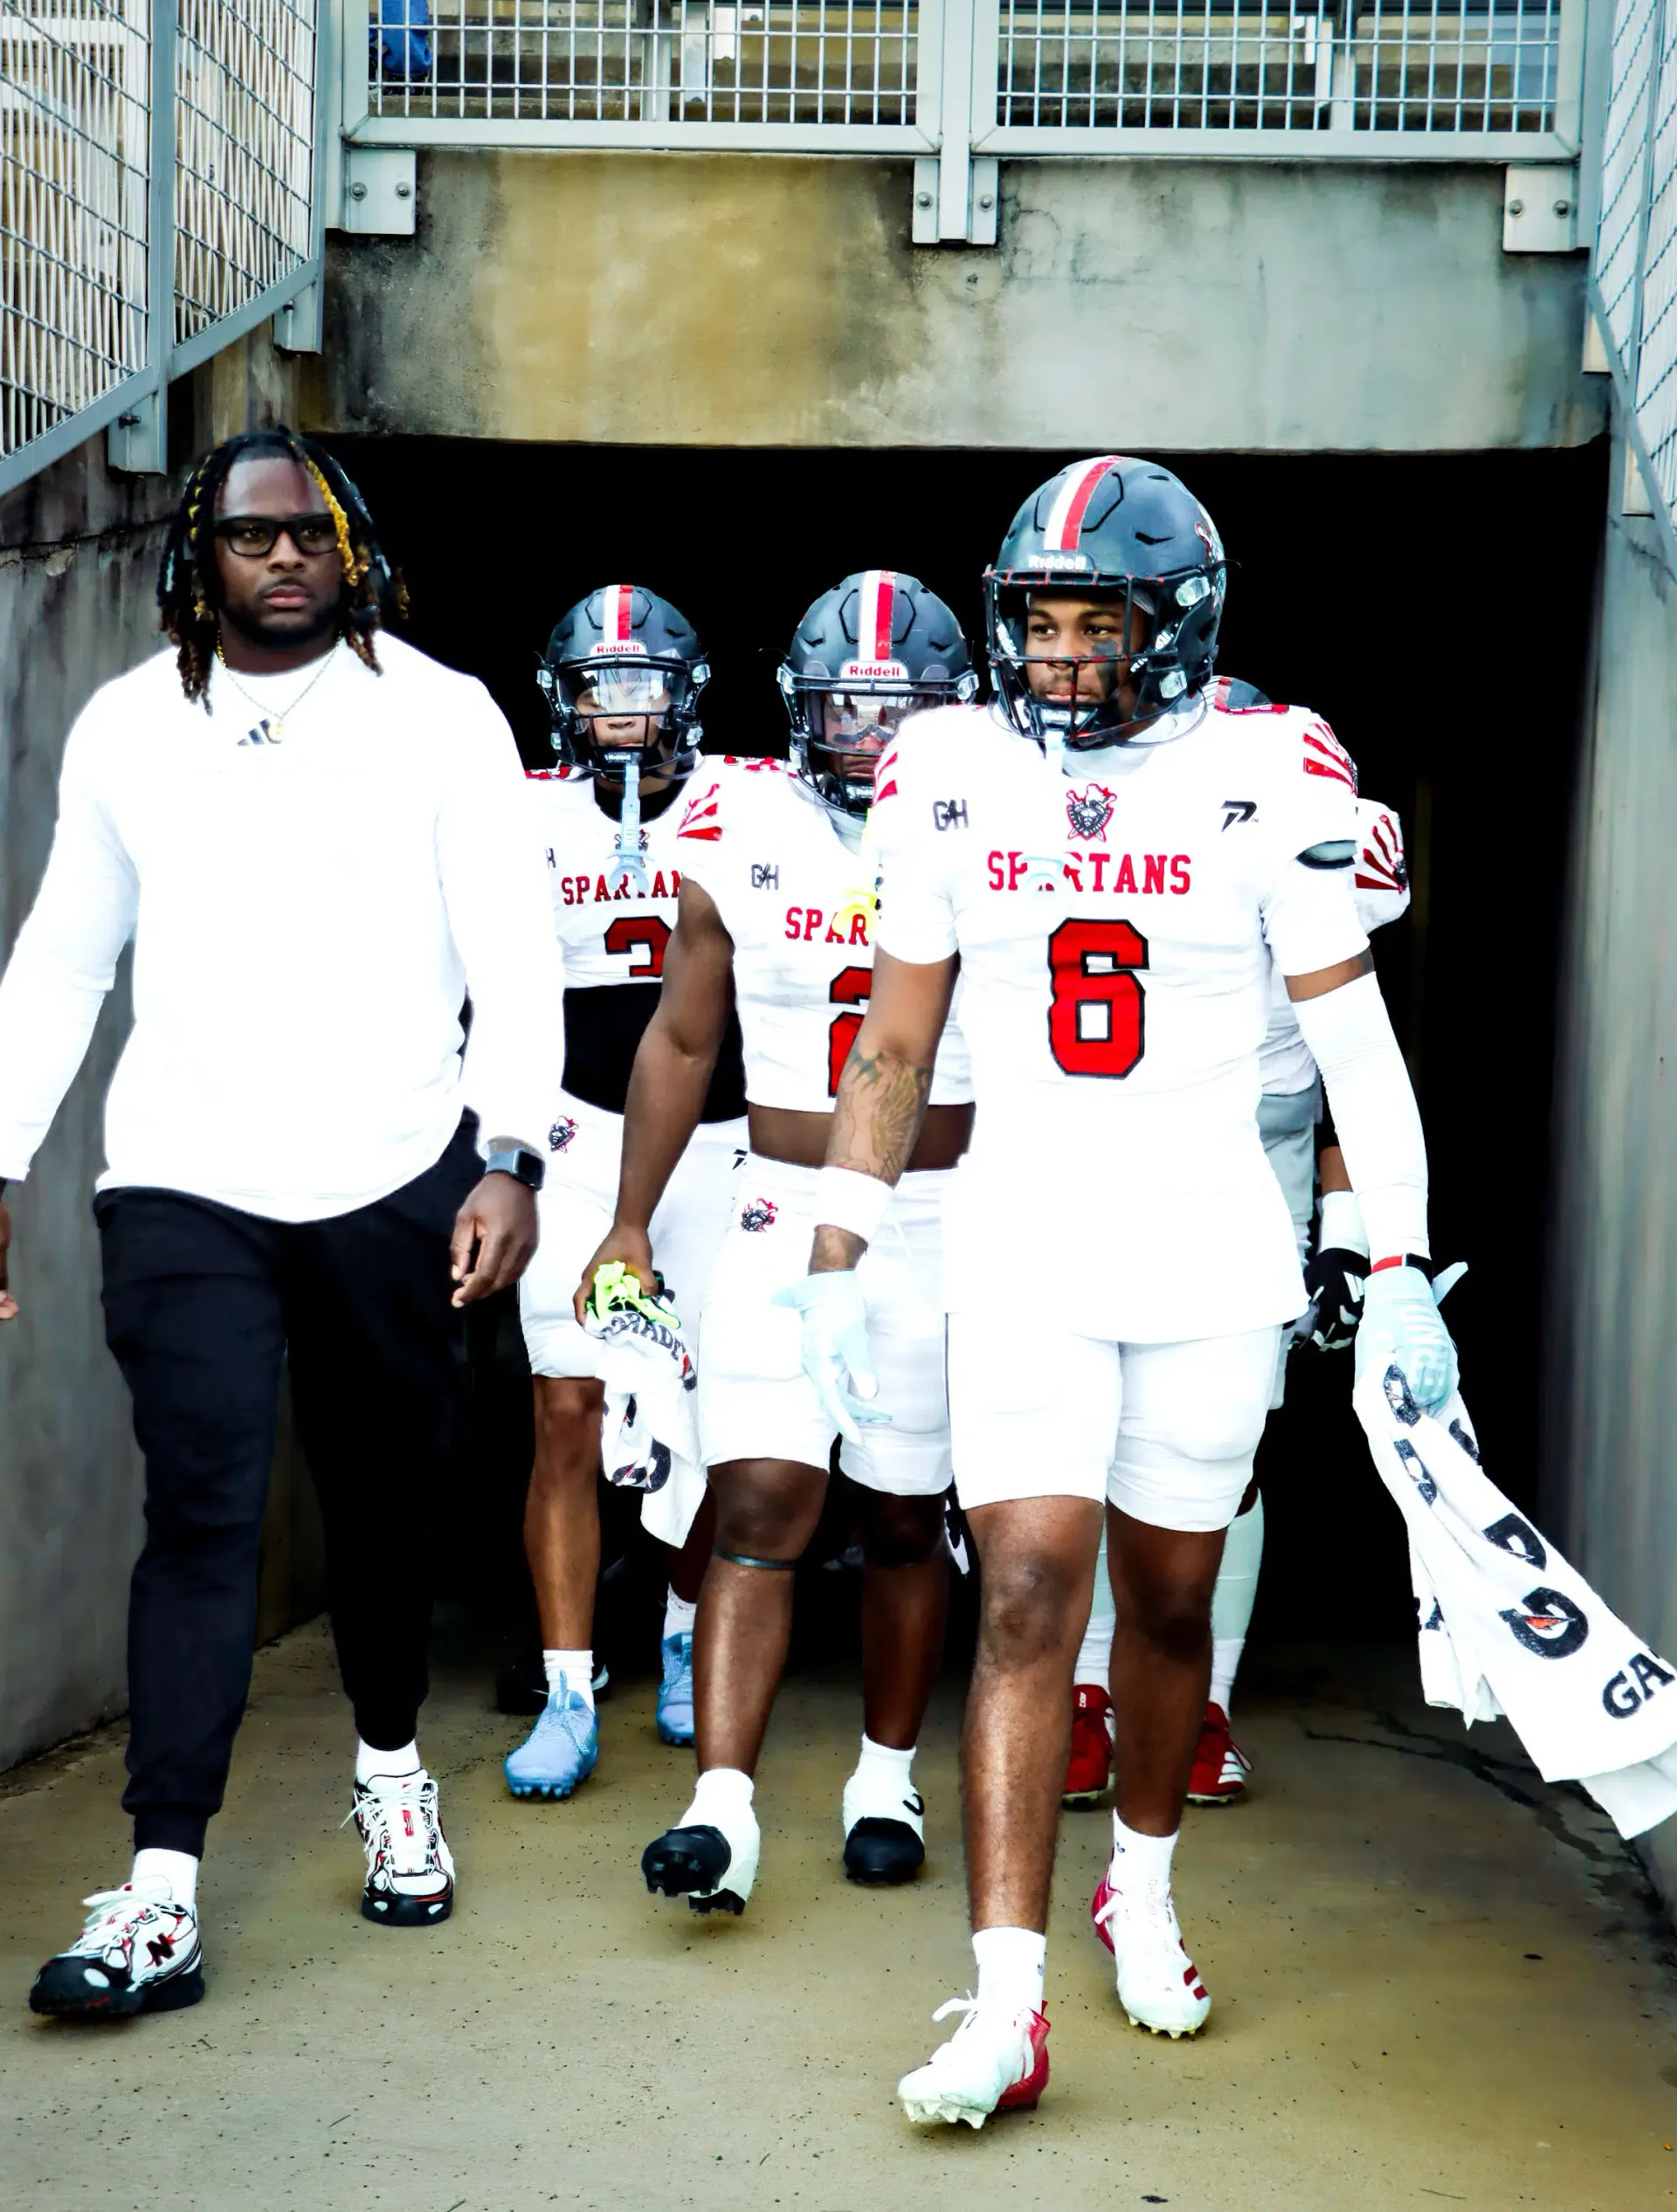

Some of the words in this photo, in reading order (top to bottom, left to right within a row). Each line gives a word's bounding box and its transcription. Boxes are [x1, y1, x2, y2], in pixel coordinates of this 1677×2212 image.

[1028, 555, 1087, 569] Riddell
[597, 644, 639, 653] Riddell
[849, 665, 900, 677] Riddell
[988, 851, 1191, 894] SPRTANS
[1047, 917, 1149, 1080] 6
[1602, 1648, 1676, 1719] GA
